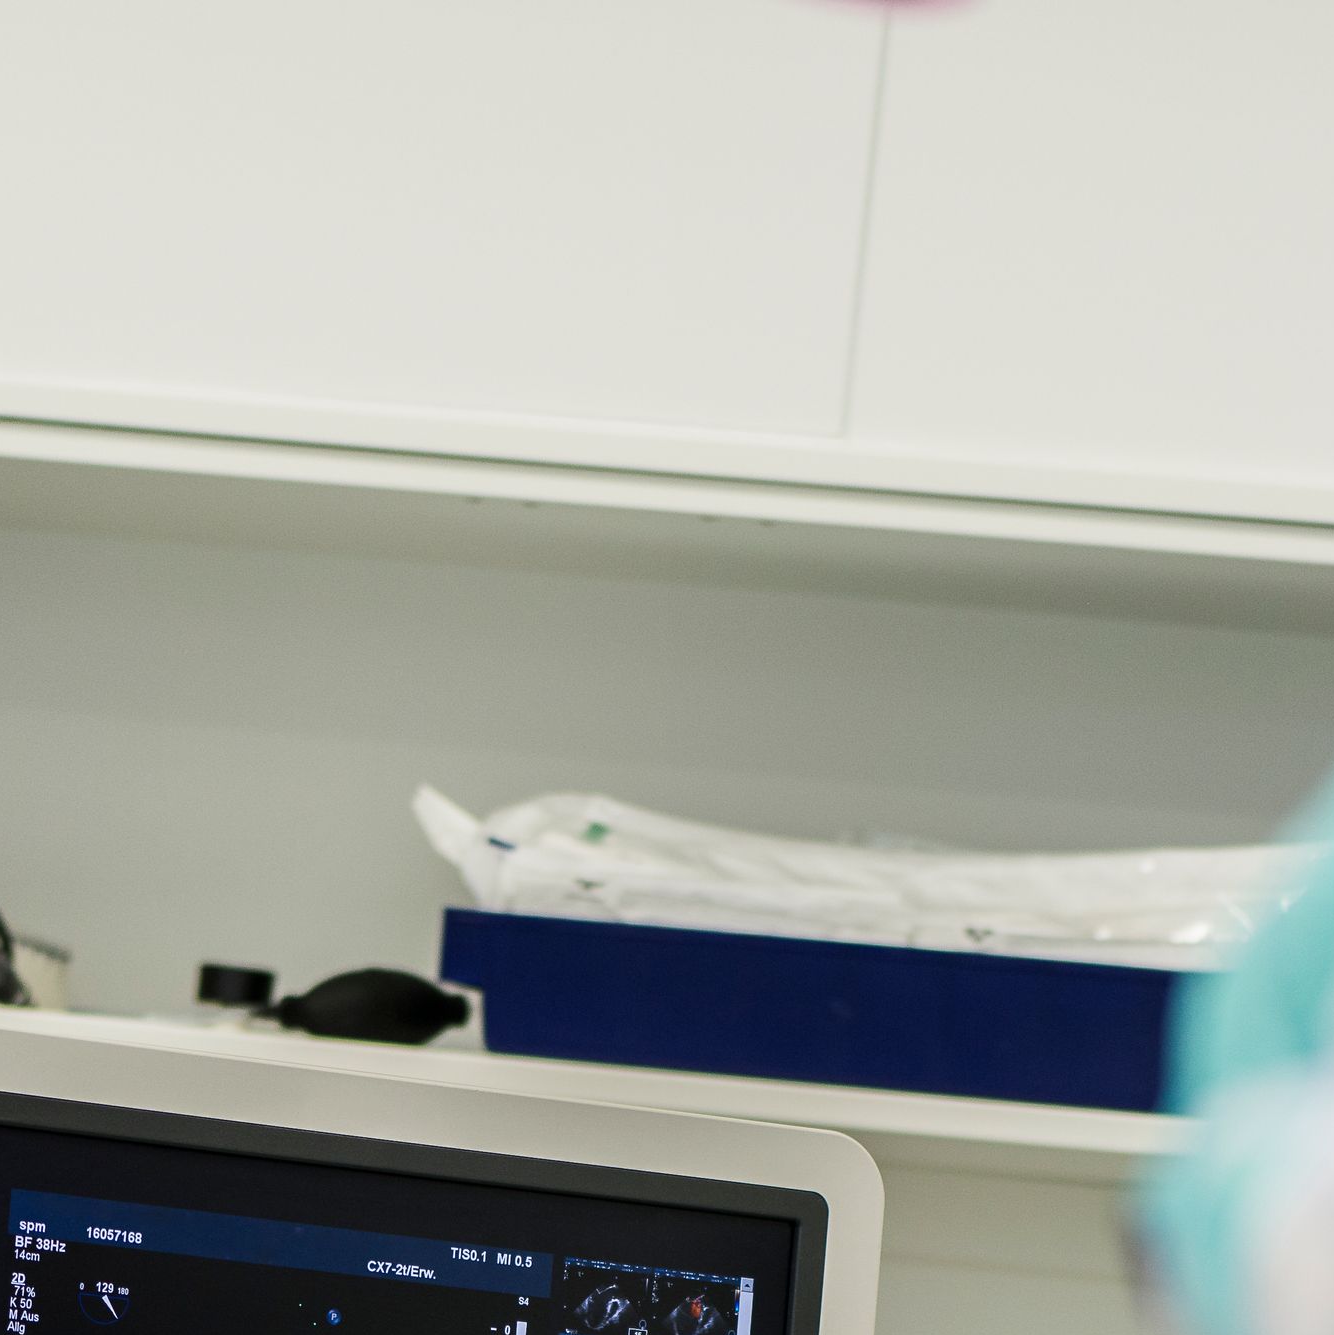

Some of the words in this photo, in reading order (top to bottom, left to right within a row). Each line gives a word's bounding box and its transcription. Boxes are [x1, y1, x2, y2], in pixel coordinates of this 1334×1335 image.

[19, 1220, 46, 1234] spm
[86, 1226, 143, 1244] 16057168
[14, 1235, 32, 1248] BF
[35, 1238, 66, 1252] 38Hz
[14, 1249, 40, 1262] 14cm
[496, 1252, 512, 1266] MI
[514, 1255, 533, 1268] 0.5
[367, 1260, 436, 1280] CX7-2t/Erw.
[11, 1272, 26, 1285] 2D
[14, 1285, 36, 1298] 71%
[79, 1282, 85, 1290] 0
[96, 1281, 115, 1294] 129
[117, 1287, 130, 1296] 180
[9, 1297, 18, 1308] K
[19, 1298, 33, 1310] 50
[518, 1296, 529, 1306] S4
[8, 1309, 18, 1320] M
[20, 1311, 40, 1323] Aus
[7, 1320, 26, 1335] Allg
[504, 1325, 511, 1335] 0
